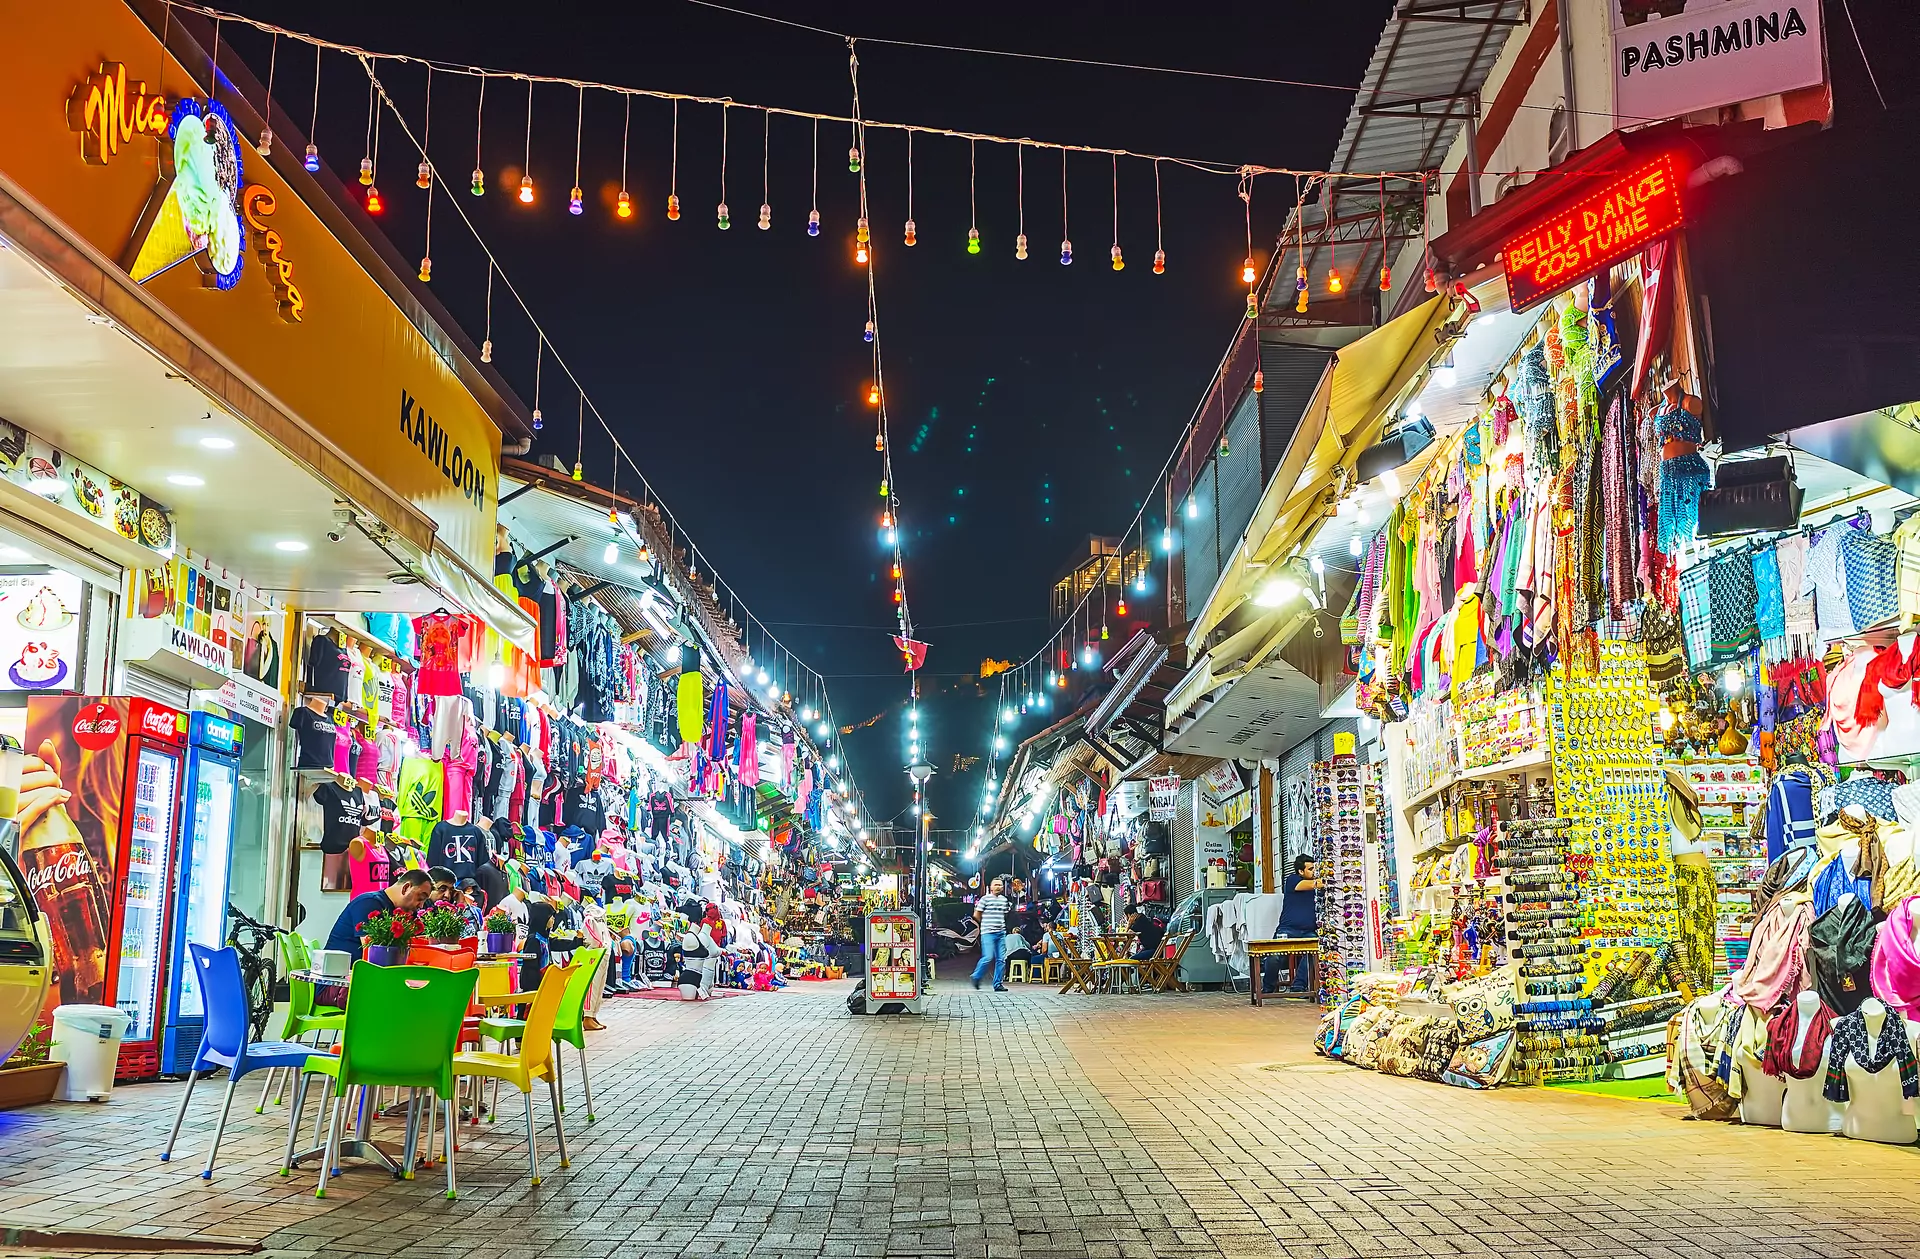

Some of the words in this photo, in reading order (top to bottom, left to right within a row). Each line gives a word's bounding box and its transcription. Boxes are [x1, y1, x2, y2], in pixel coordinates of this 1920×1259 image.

[1621, 8, 1806, 77] PASHMINA
[84, 63, 168, 165] Mia
[1509, 219, 1572, 272] BELLY
[1583, 170, 1666, 232] DANCE
[1534, 206, 1649, 284] COSTUME
[400, 388, 485, 512] KAWLOON
[171, 628, 225, 668] KAWLOON
[1237, 832, 1252, 840] Dr.
